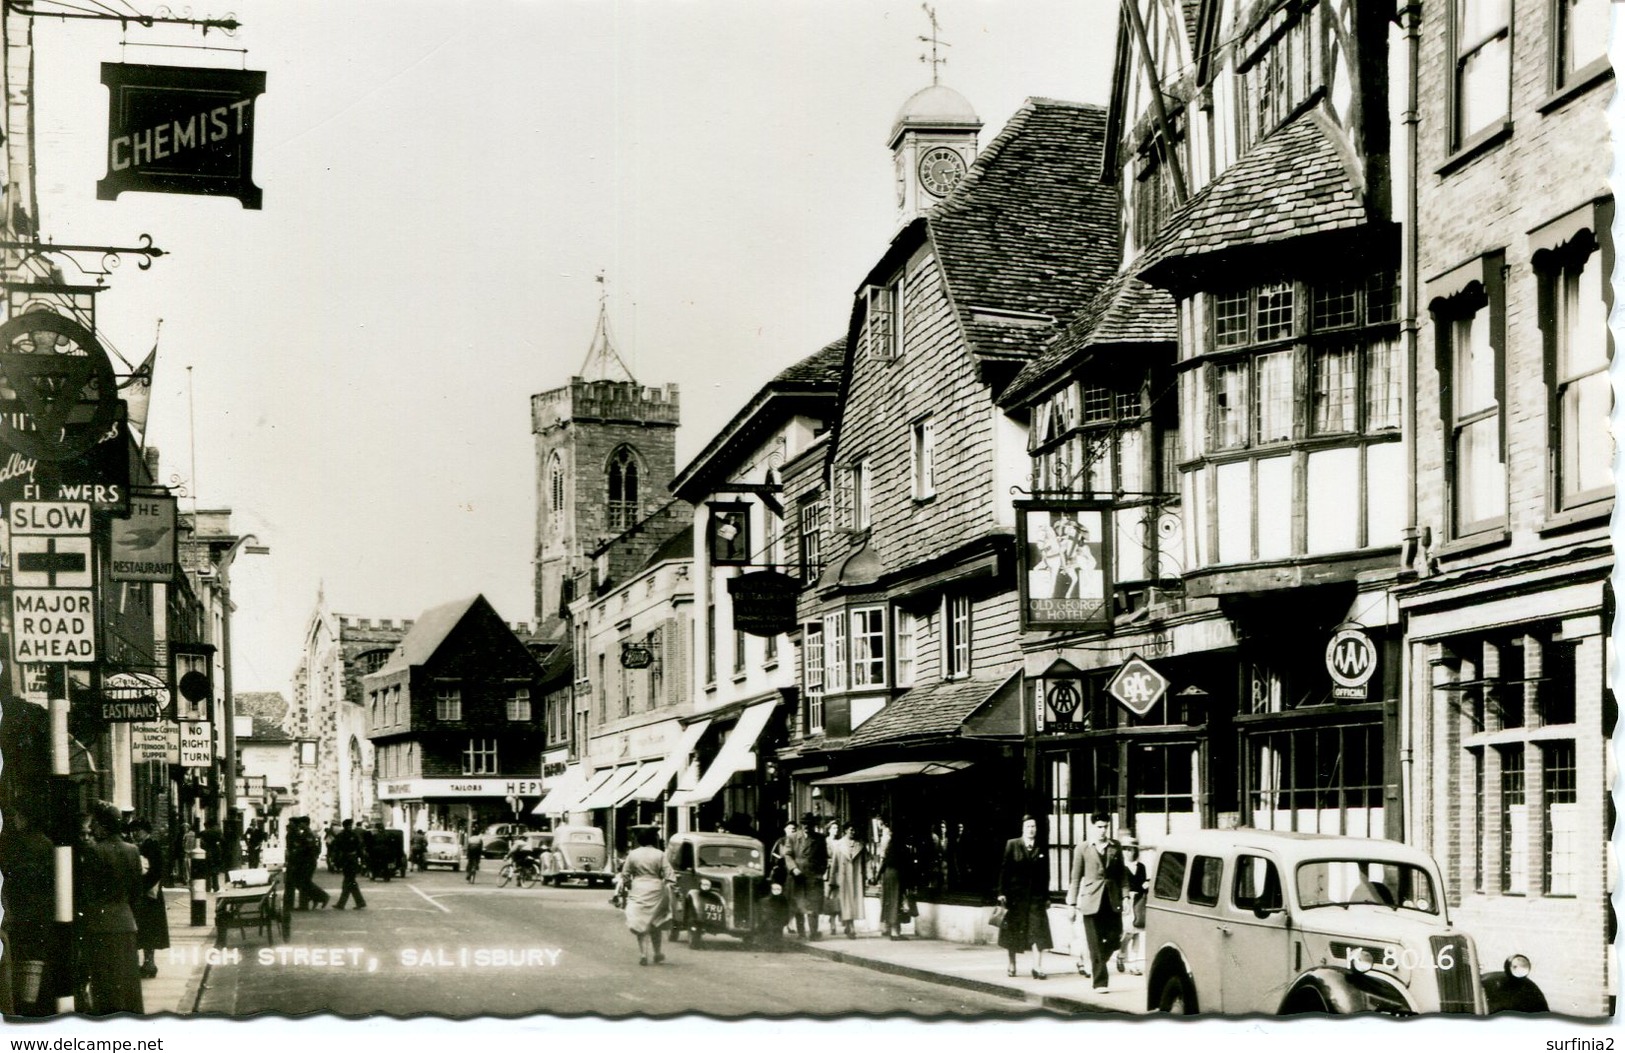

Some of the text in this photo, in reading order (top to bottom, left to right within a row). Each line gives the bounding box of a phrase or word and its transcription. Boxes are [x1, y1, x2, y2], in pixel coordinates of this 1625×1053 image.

[111, 100, 250, 171] CHEMIST
[131, 503, 160, 516] THE
[14, 506, 87, 529] SLOW
[113, 561, 173, 575] RESTAURANT
[16, 596, 91, 613] MAJOR
[1029, 599, 1102, 610] OLD GEORGE
[1047, 610, 1087, 620] HOTEL
[23, 618, 85, 634] ROAD
[18, 640, 93, 656] AHEAD
[1335, 688, 1365, 697] OFFICIAL
[102, 703, 155, 718] EASTMANS
[188, 727, 203, 736] NO
[1050, 722, 1079, 730] HOTEL
[182, 739, 210, 748] RIGHT
[183, 752, 210, 761] TURN
[450, 784, 482, 792] TAILORS
[705, 903, 723, 913] FRU
